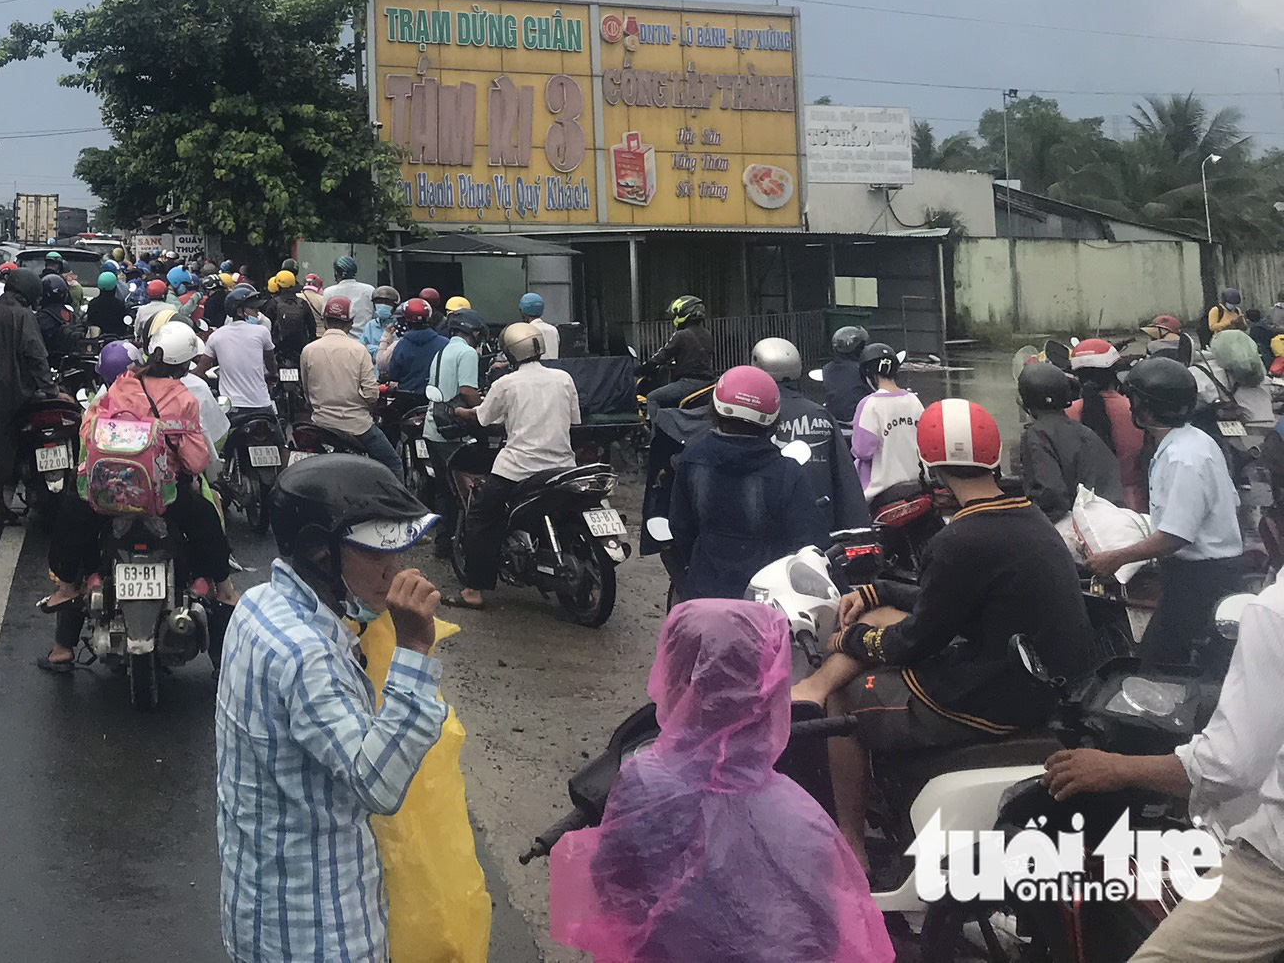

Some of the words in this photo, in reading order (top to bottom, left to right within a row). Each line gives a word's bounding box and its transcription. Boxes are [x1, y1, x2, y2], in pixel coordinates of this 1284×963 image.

[384, 7, 452, 51] TRẠM
[456, 4, 519, 49] DỪNG
[523, 8, 583, 53] CHÂN
[639, 23, 671, 46] DNTN
[544, 74, 586, 173] 3
[416, 173, 454, 217] Hạnh
[457, 174, 492, 218] Phục
[493, 174, 512, 219] Vụ
[516, 174, 541, 218] Quý
[545, 174, 591, 211] Khách
[119, 582, 162, 597] 387.51
